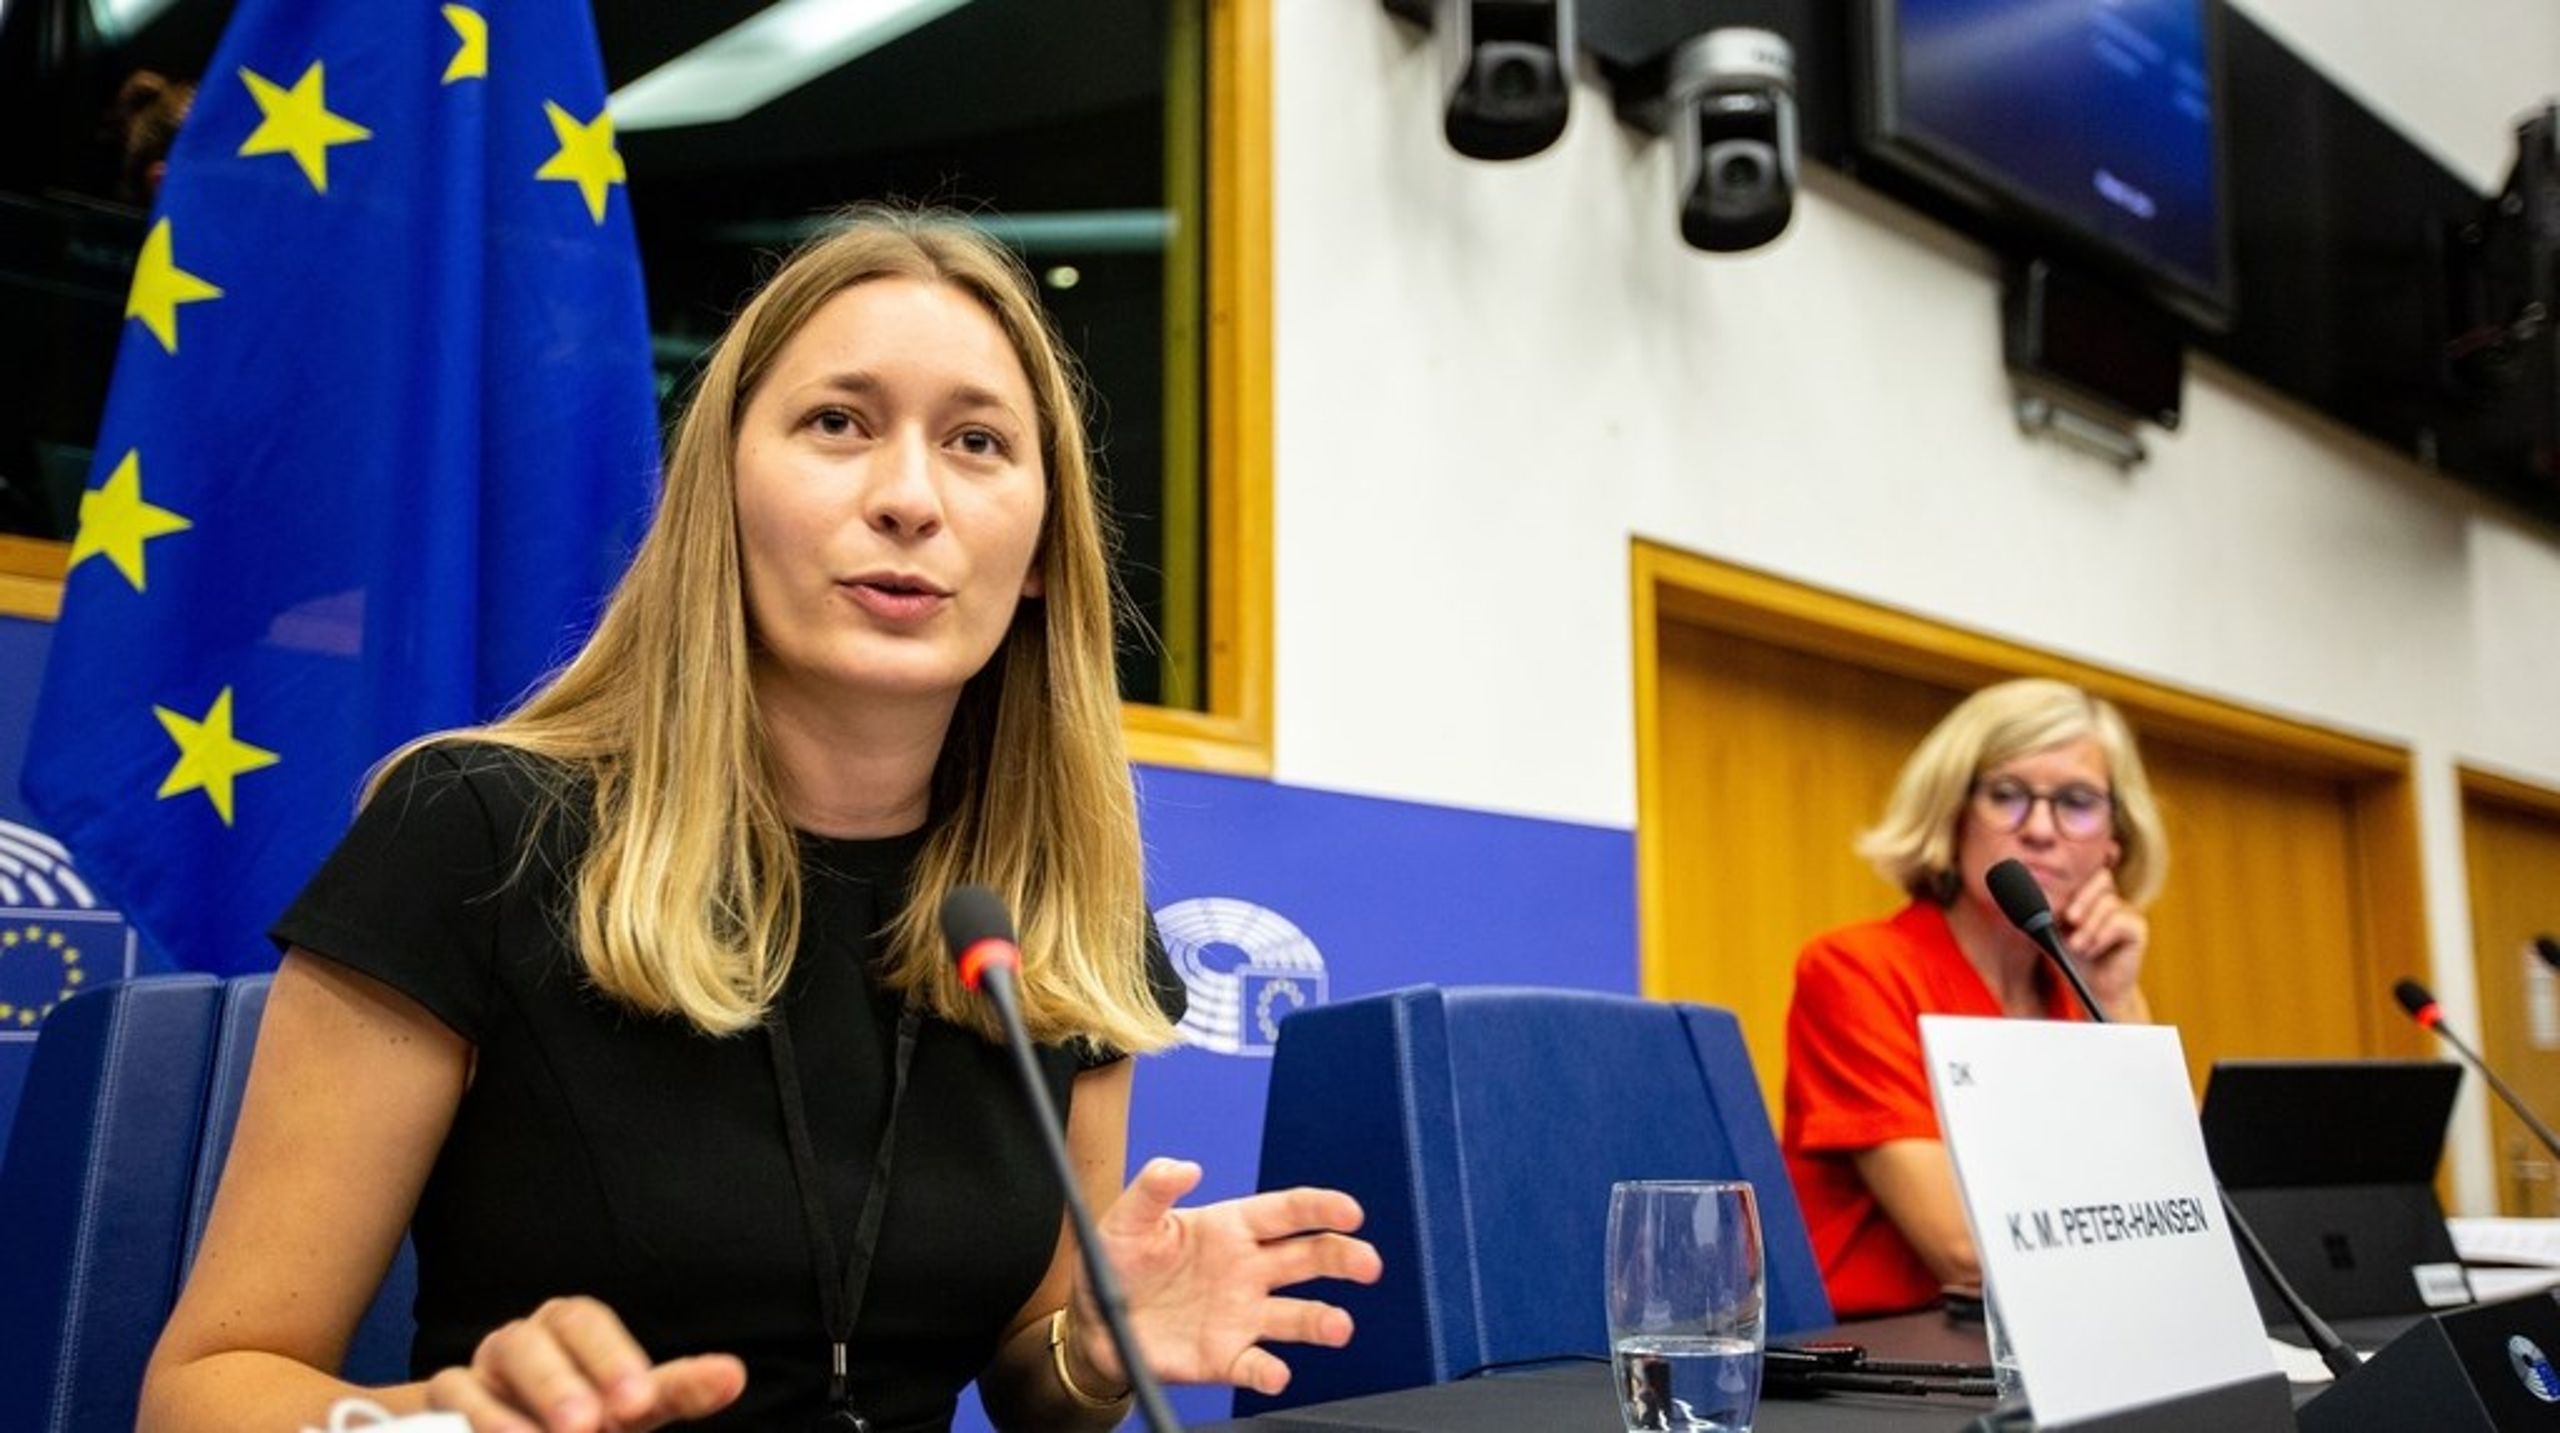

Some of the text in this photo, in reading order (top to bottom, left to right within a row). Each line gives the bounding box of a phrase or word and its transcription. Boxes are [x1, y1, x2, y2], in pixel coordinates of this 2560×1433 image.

[1948, 1062, 1975, 1087] DK
[2006, 1198, 2208, 1252] K. M. PETER-HANSEN
